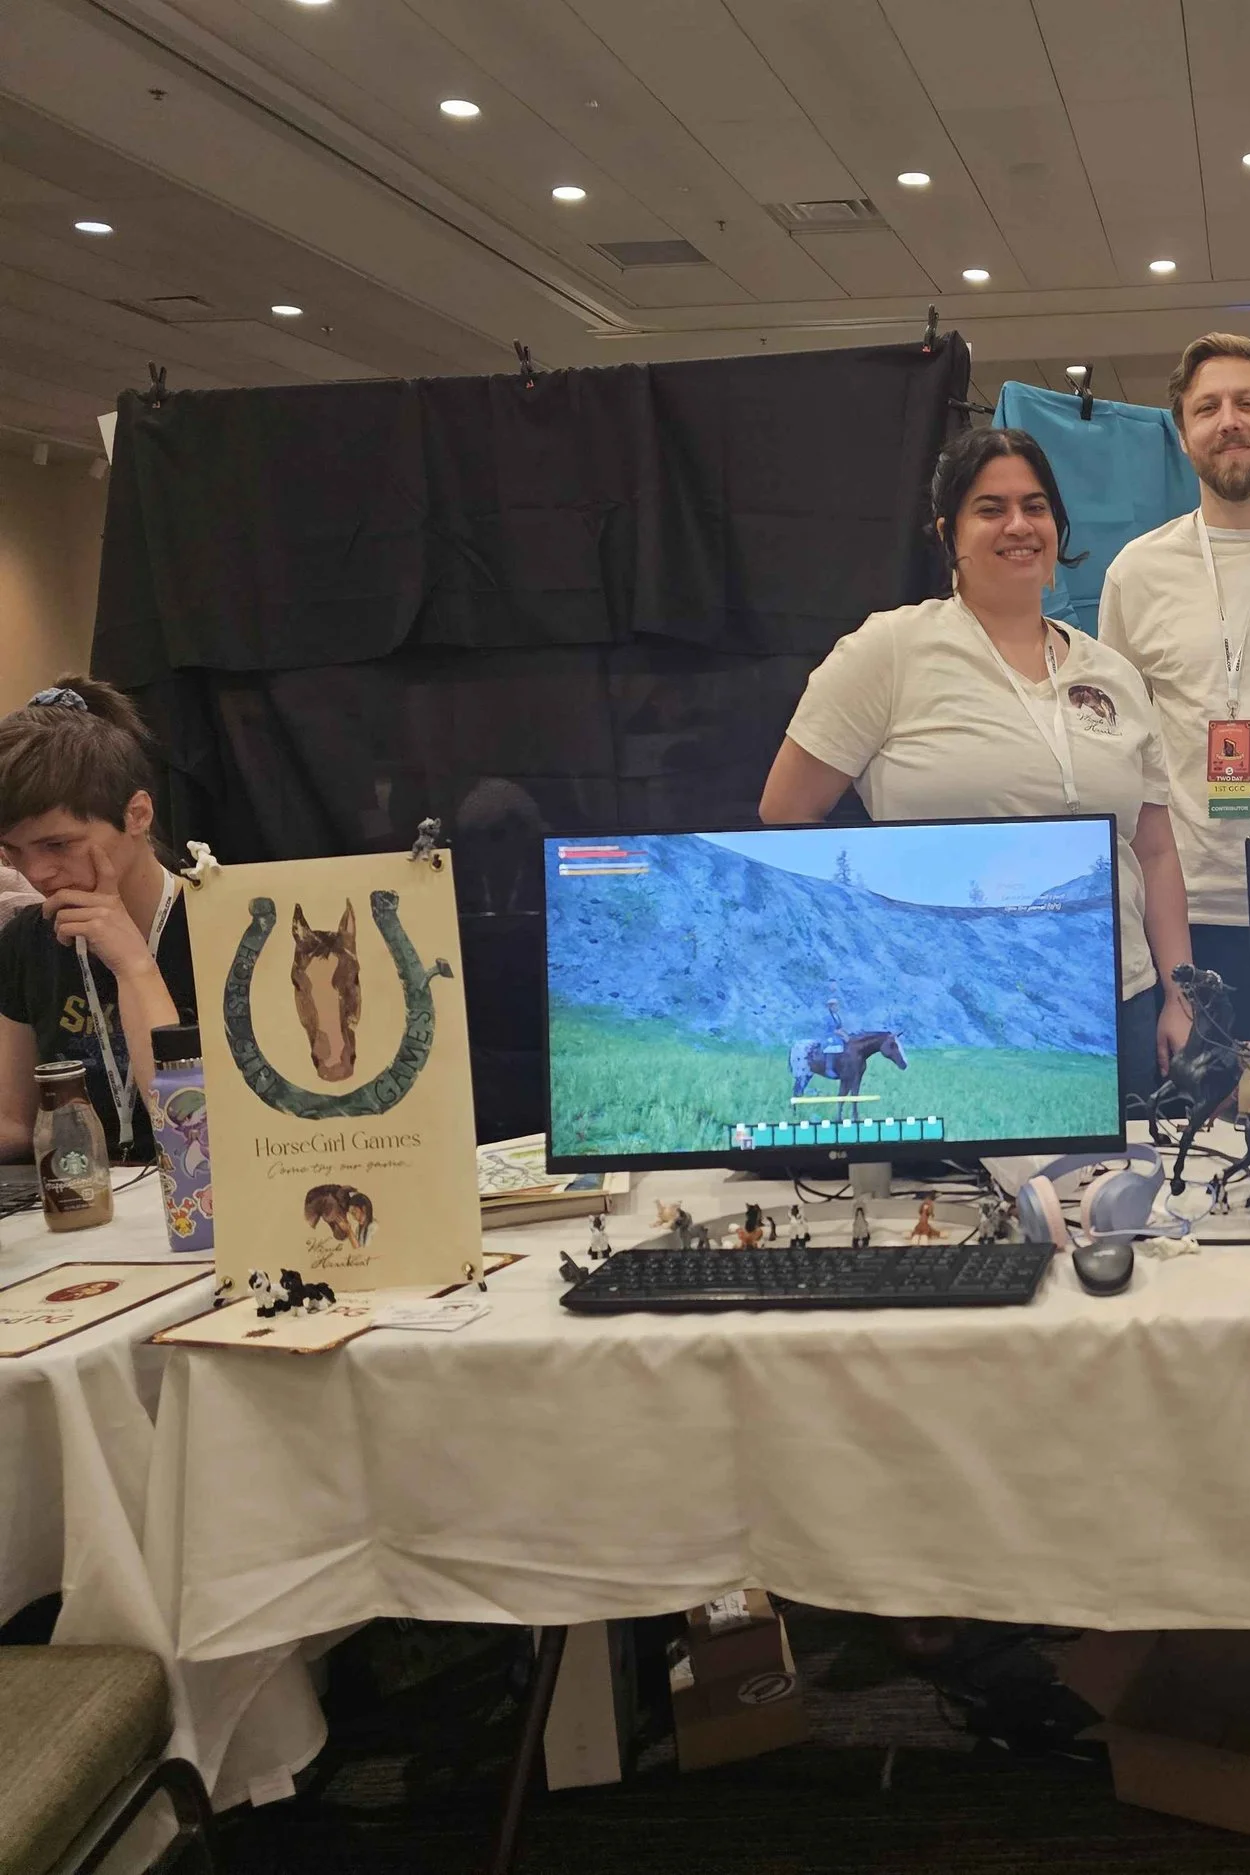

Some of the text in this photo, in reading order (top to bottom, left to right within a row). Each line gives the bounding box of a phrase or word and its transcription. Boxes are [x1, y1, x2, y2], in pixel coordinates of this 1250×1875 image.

[374, 1009, 432, 1105] GAMES
[255, 1131, 422, 1158] HorseGirl Games
